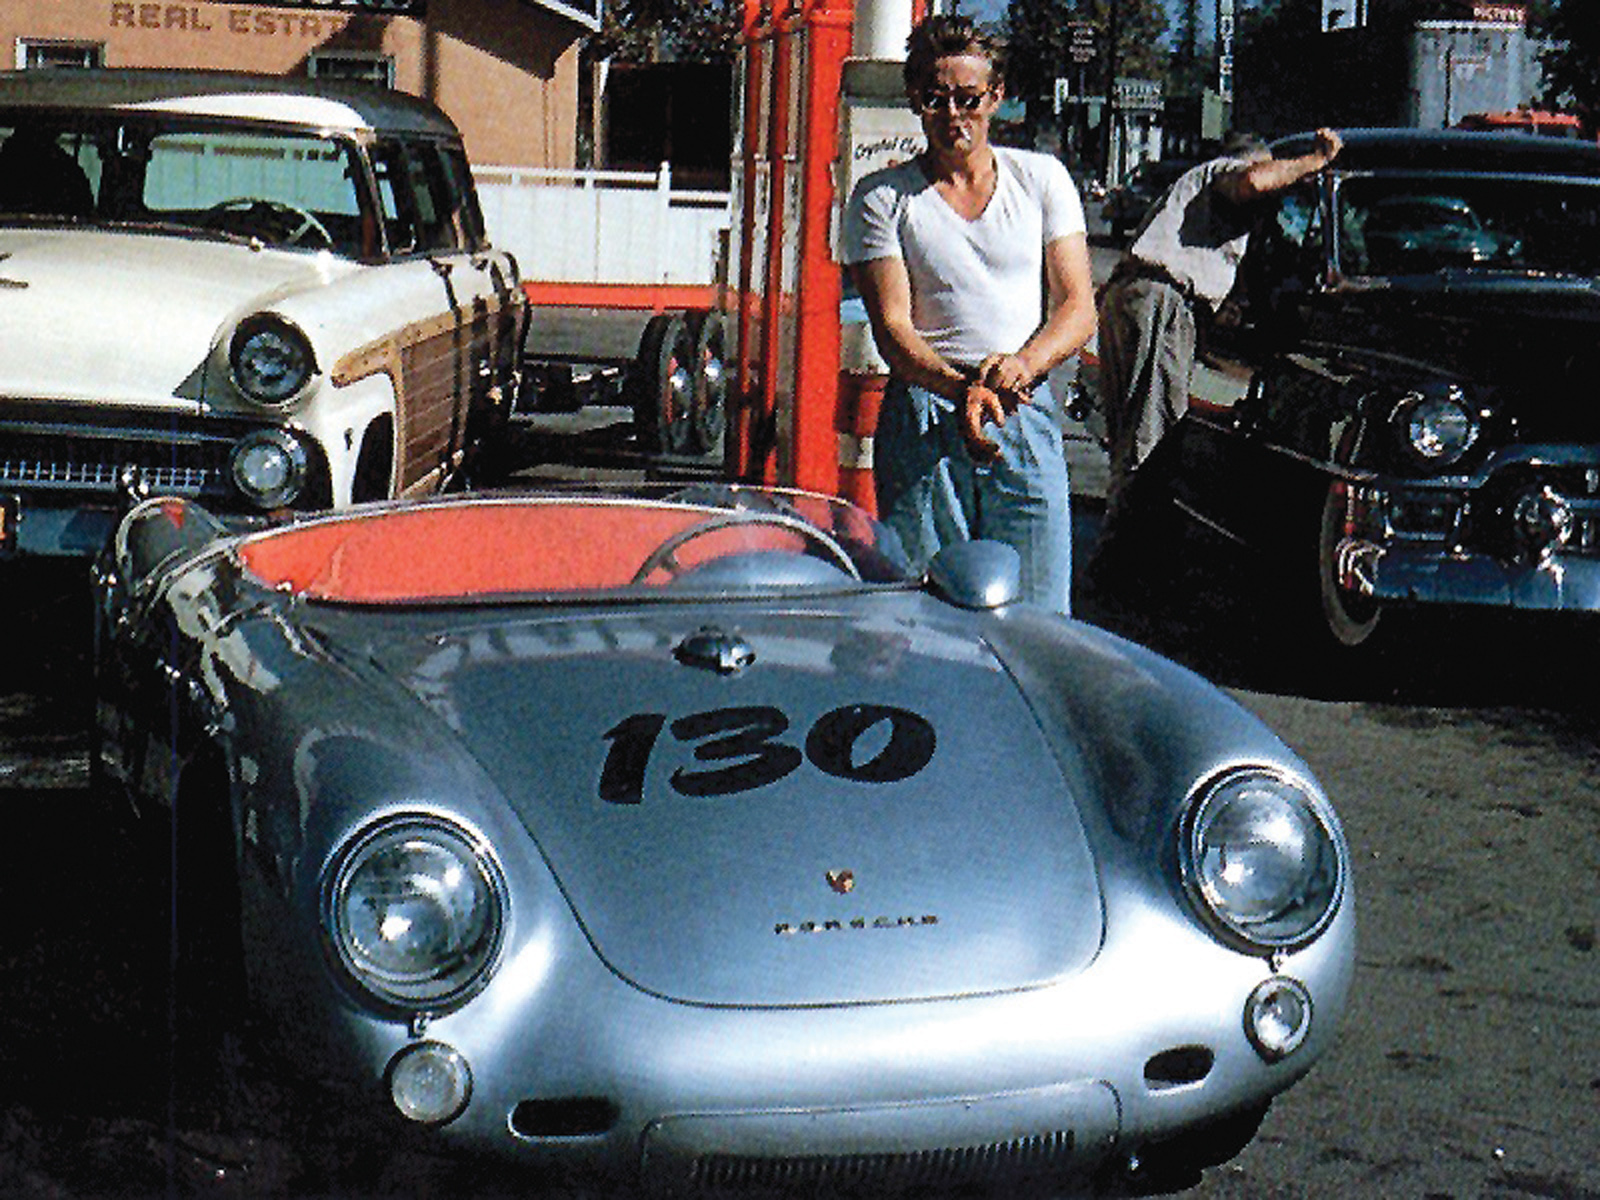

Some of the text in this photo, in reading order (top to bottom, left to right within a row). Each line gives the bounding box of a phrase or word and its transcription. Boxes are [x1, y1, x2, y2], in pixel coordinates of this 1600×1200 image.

[109, 2, 346, 37] REAL ESTAT
[599, 703, 936, 804] 130
